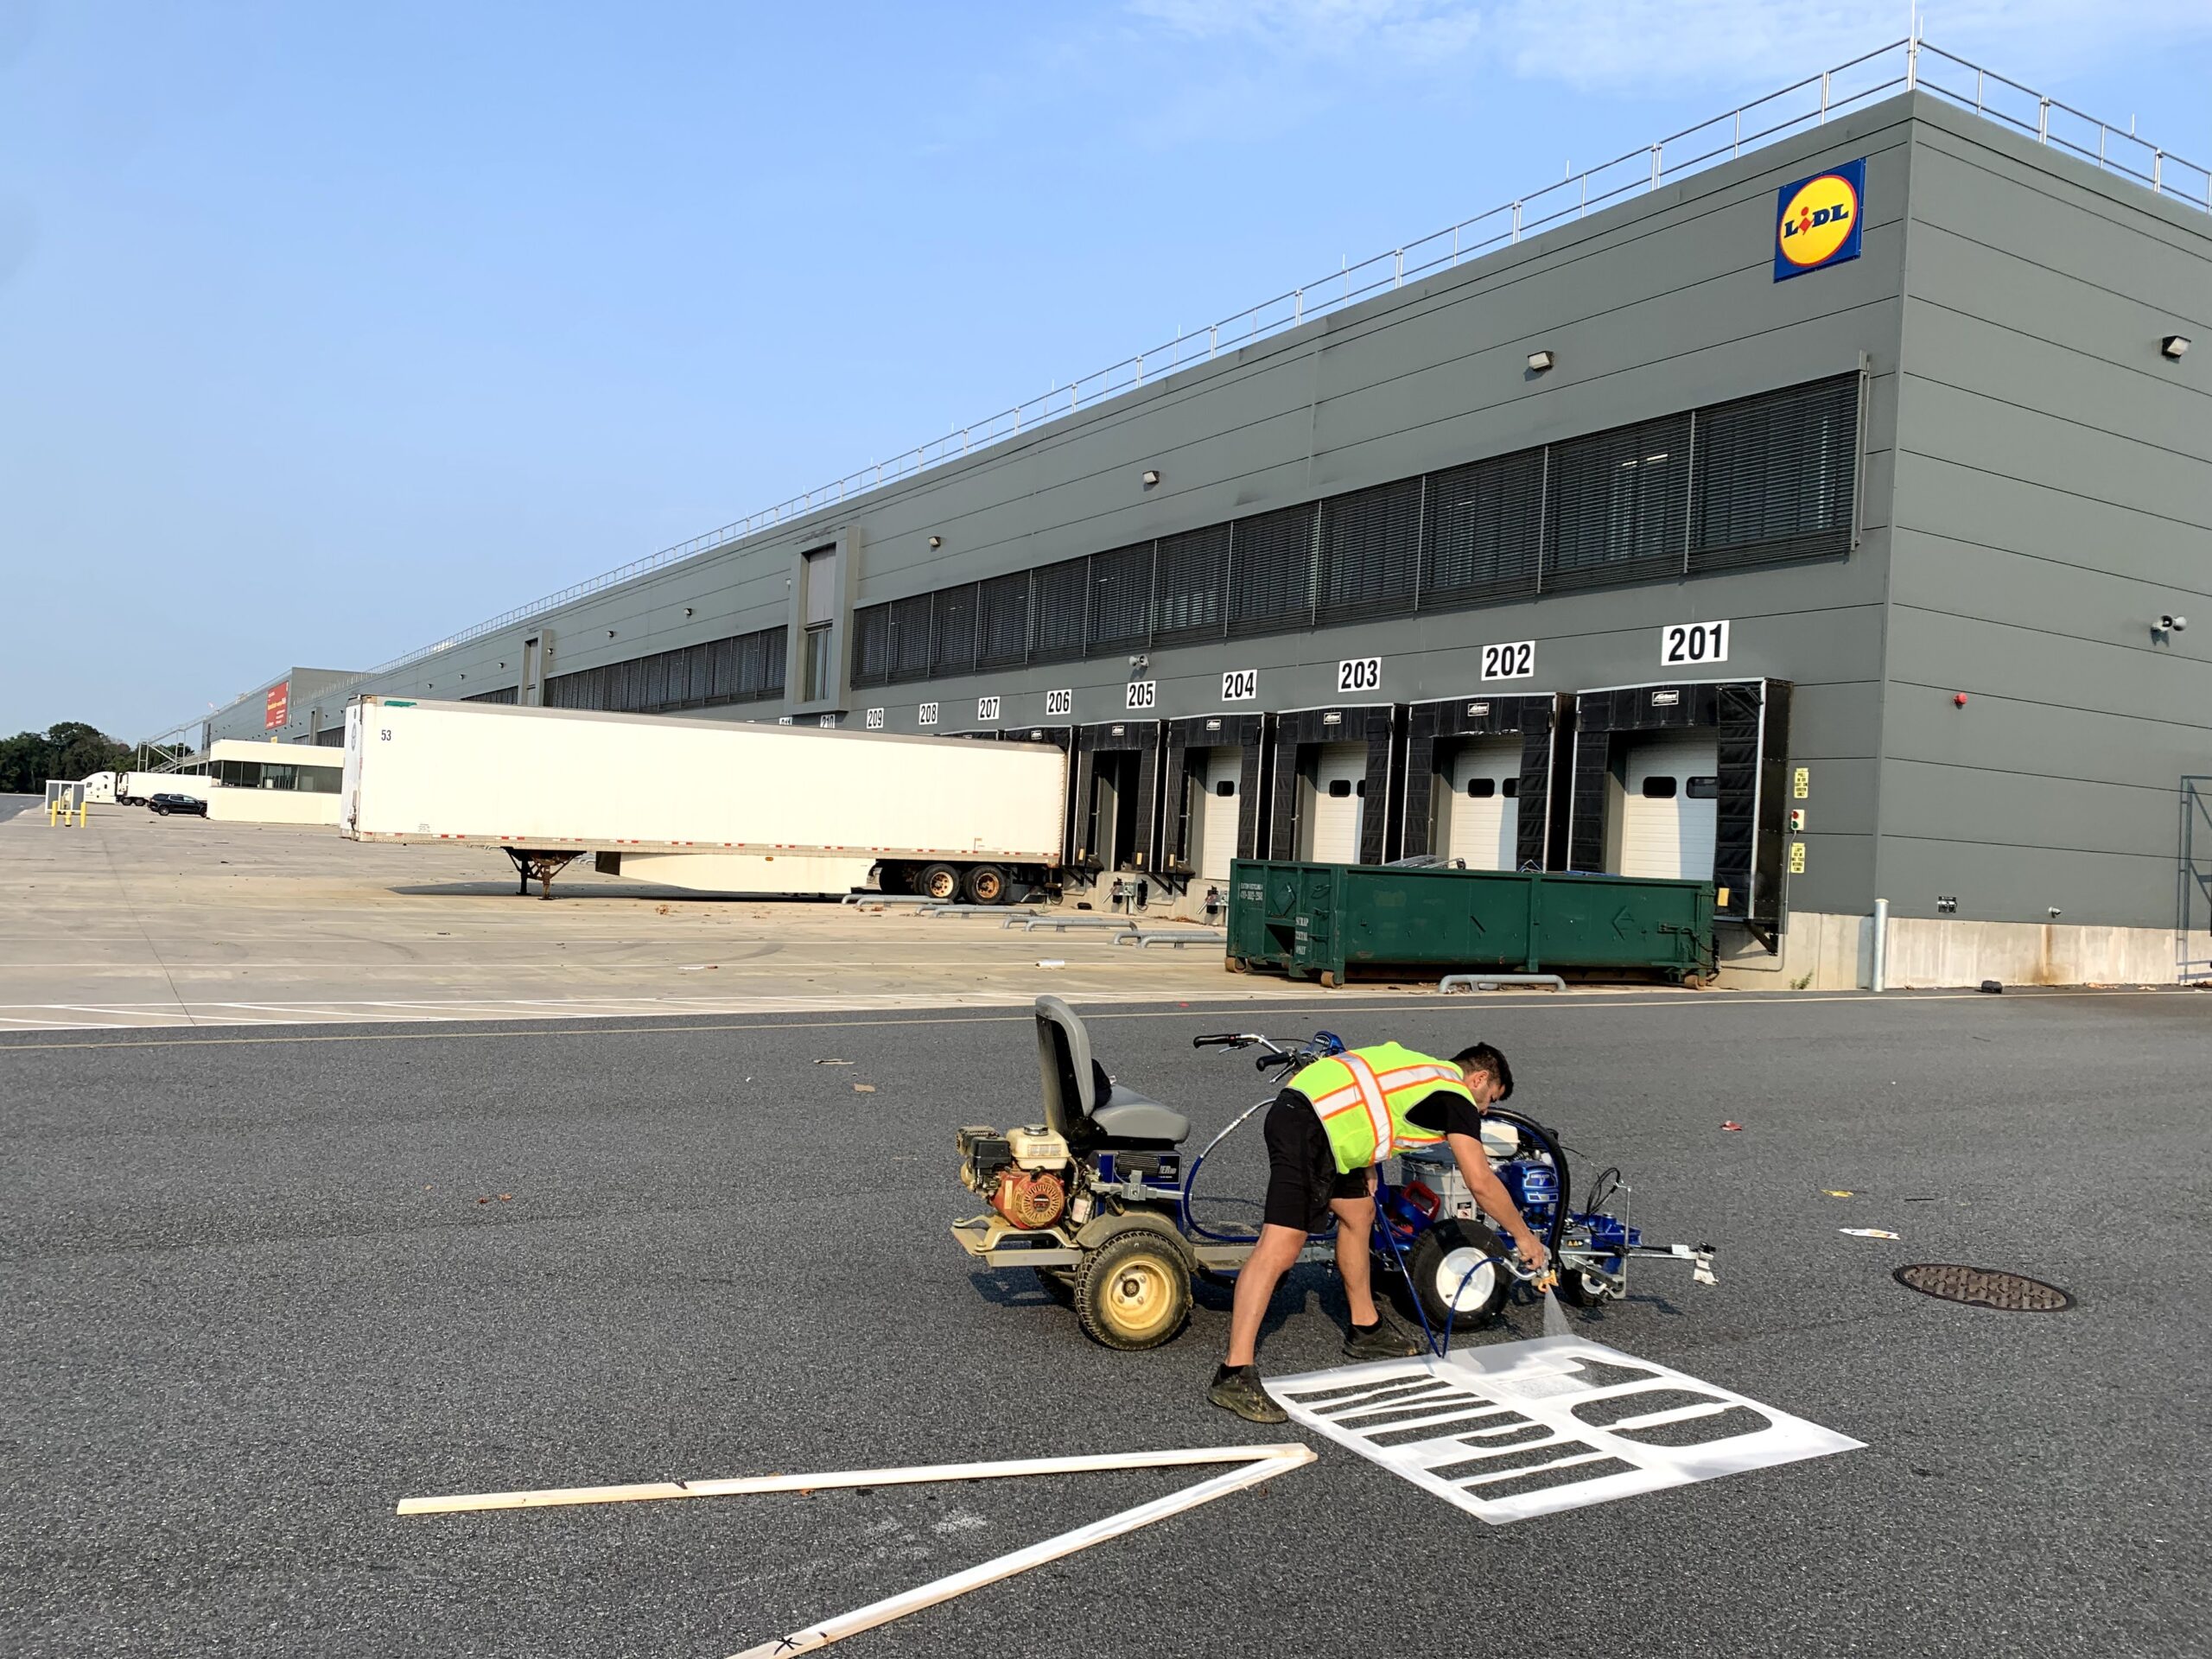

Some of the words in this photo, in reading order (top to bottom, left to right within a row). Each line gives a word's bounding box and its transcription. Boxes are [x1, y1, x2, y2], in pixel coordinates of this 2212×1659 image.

[1669, 624, 1722, 662] 201
[1485, 644, 1531, 677] 202
[1224, 672, 1254, 698] 204
[1341, 659, 1378, 689] 203
[1048, 691, 1070, 713] 206
[1128, 683, 1154, 706] 205
[868, 709, 882, 727] 209
[920, 704, 937, 722] 208
[980, 698, 998, 718] 207
[381, 729, 391, 741] 53
[1497, 1356, 1773, 1447] 10
[1282, 1373, 1643, 1501] MPH
